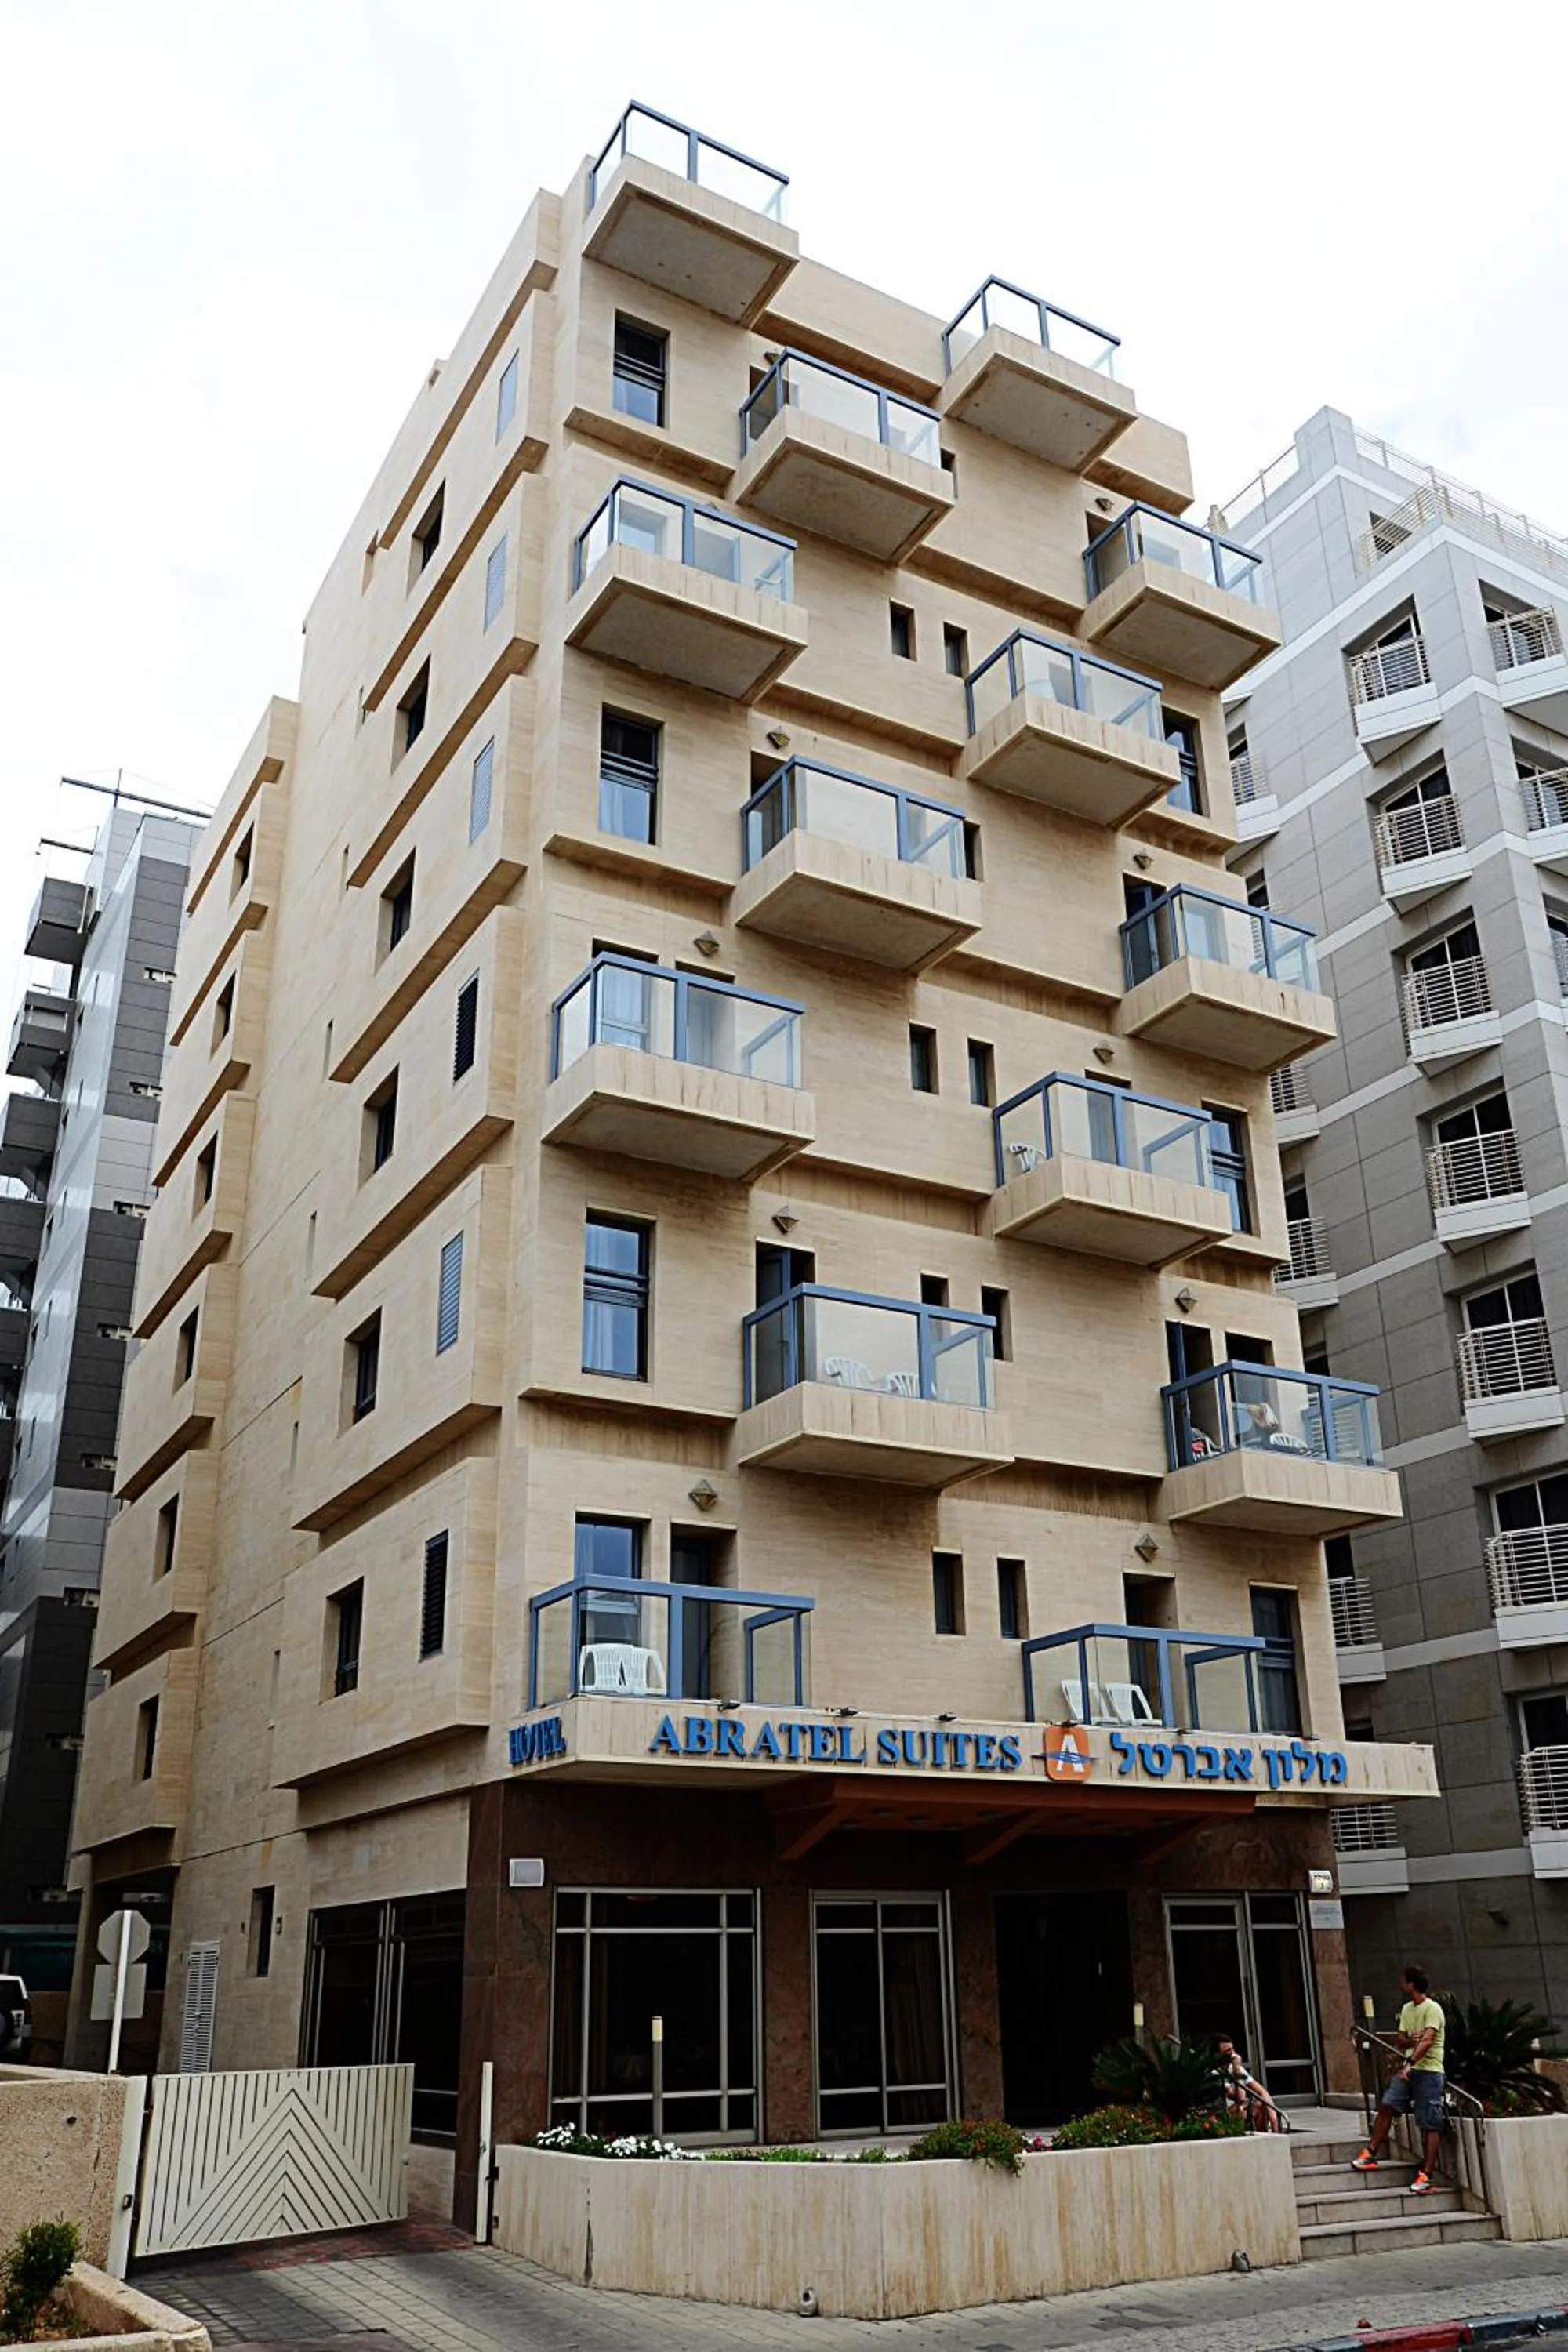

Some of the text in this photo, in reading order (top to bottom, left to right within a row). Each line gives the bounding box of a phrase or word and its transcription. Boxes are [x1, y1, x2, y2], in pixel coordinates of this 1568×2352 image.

[508, 1716, 567, 1765] HOTEL
[648, 1714, 1022, 1769] ABRATEL SUITES
[1110, 1732, 1348, 1789] מלון אברטל
